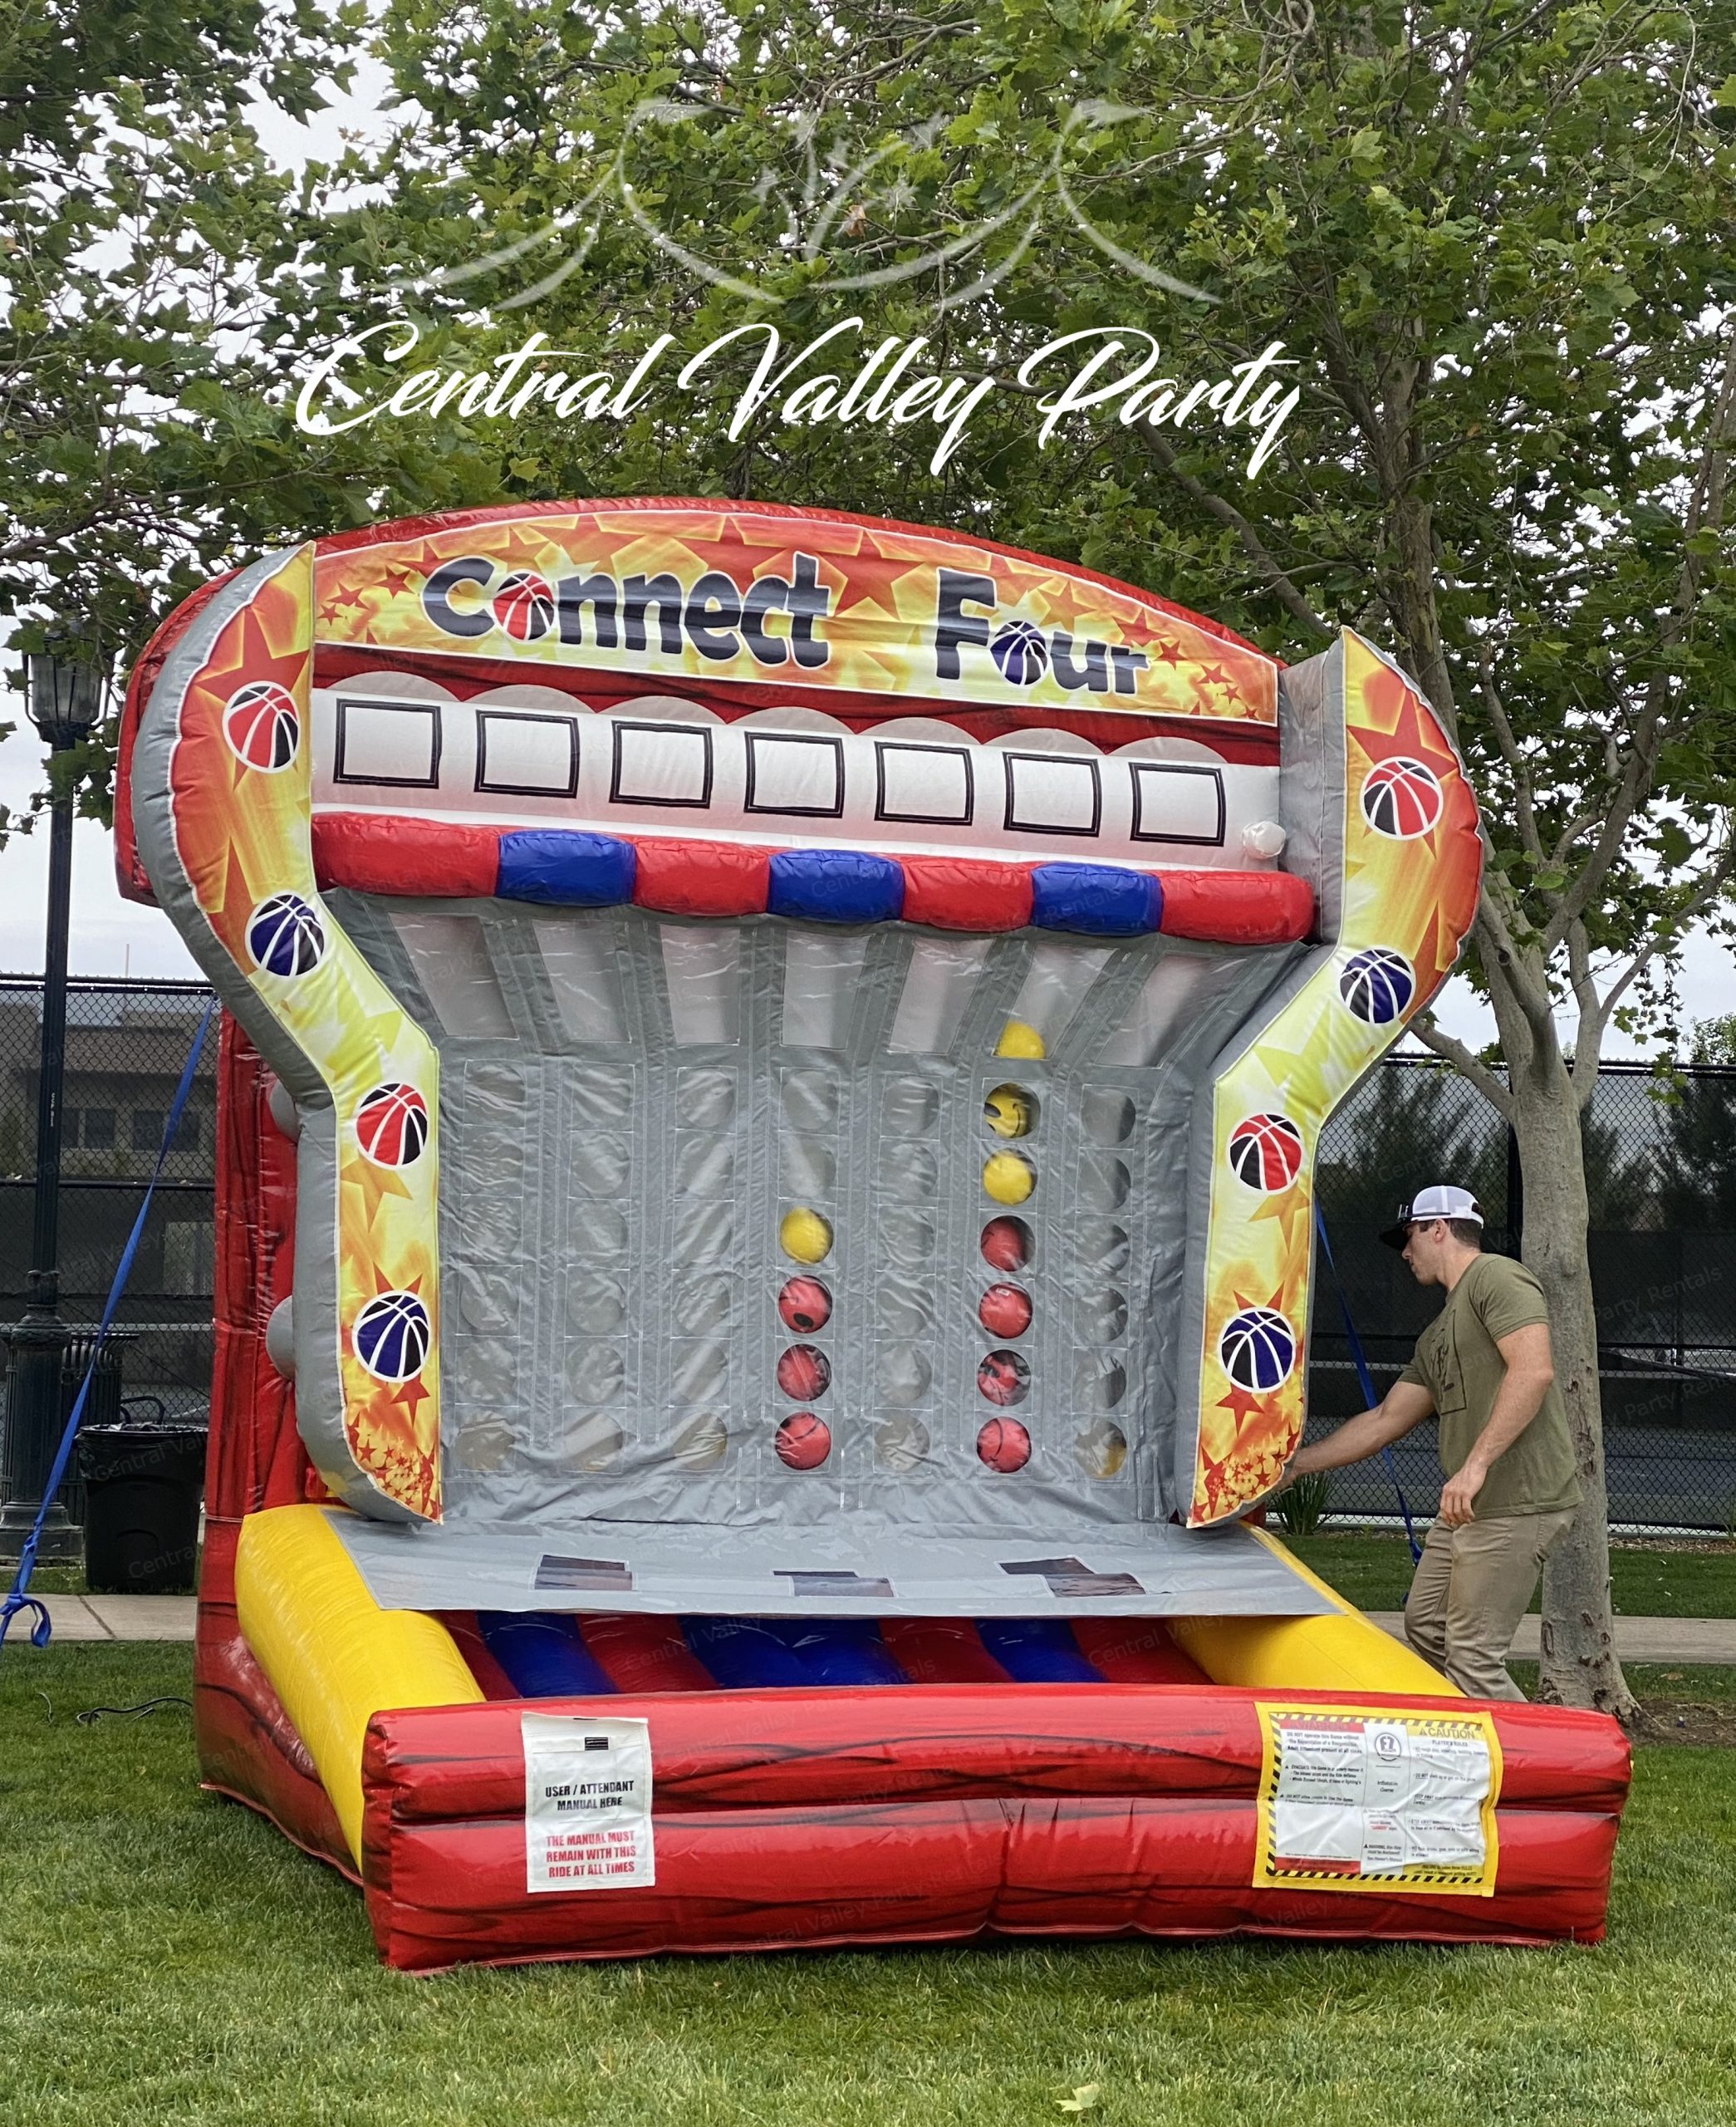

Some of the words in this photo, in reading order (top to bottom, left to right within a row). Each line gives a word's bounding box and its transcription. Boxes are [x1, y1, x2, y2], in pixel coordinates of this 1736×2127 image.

[1429, 1728, 1475, 1739] CAUTION
[545, 1785, 571, 1797] USER
[573, 1785, 578, 1795] /
[580, 1781, 635, 1795] ATTENDANT
[557, 1798, 597, 1810] MANUAL
[600, 1796, 623, 1808] HERE
[547, 1835, 565, 1847] THE
[567, 1833, 606, 1846] MANUAL
[608, 1830, 635, 1842] MUST
[547, 1849, 584, 1862] REMAIN
[586, 1848, 611, 1859] WITH
[614, 1846, 636, 1858] THIS
[549, 1865, 571, 1878] RIDE
[573, 1866, 585, 1876] AT
[587, 1864, 604, 1875] ALL
[606, 1861, 635, 1874] TIMES
